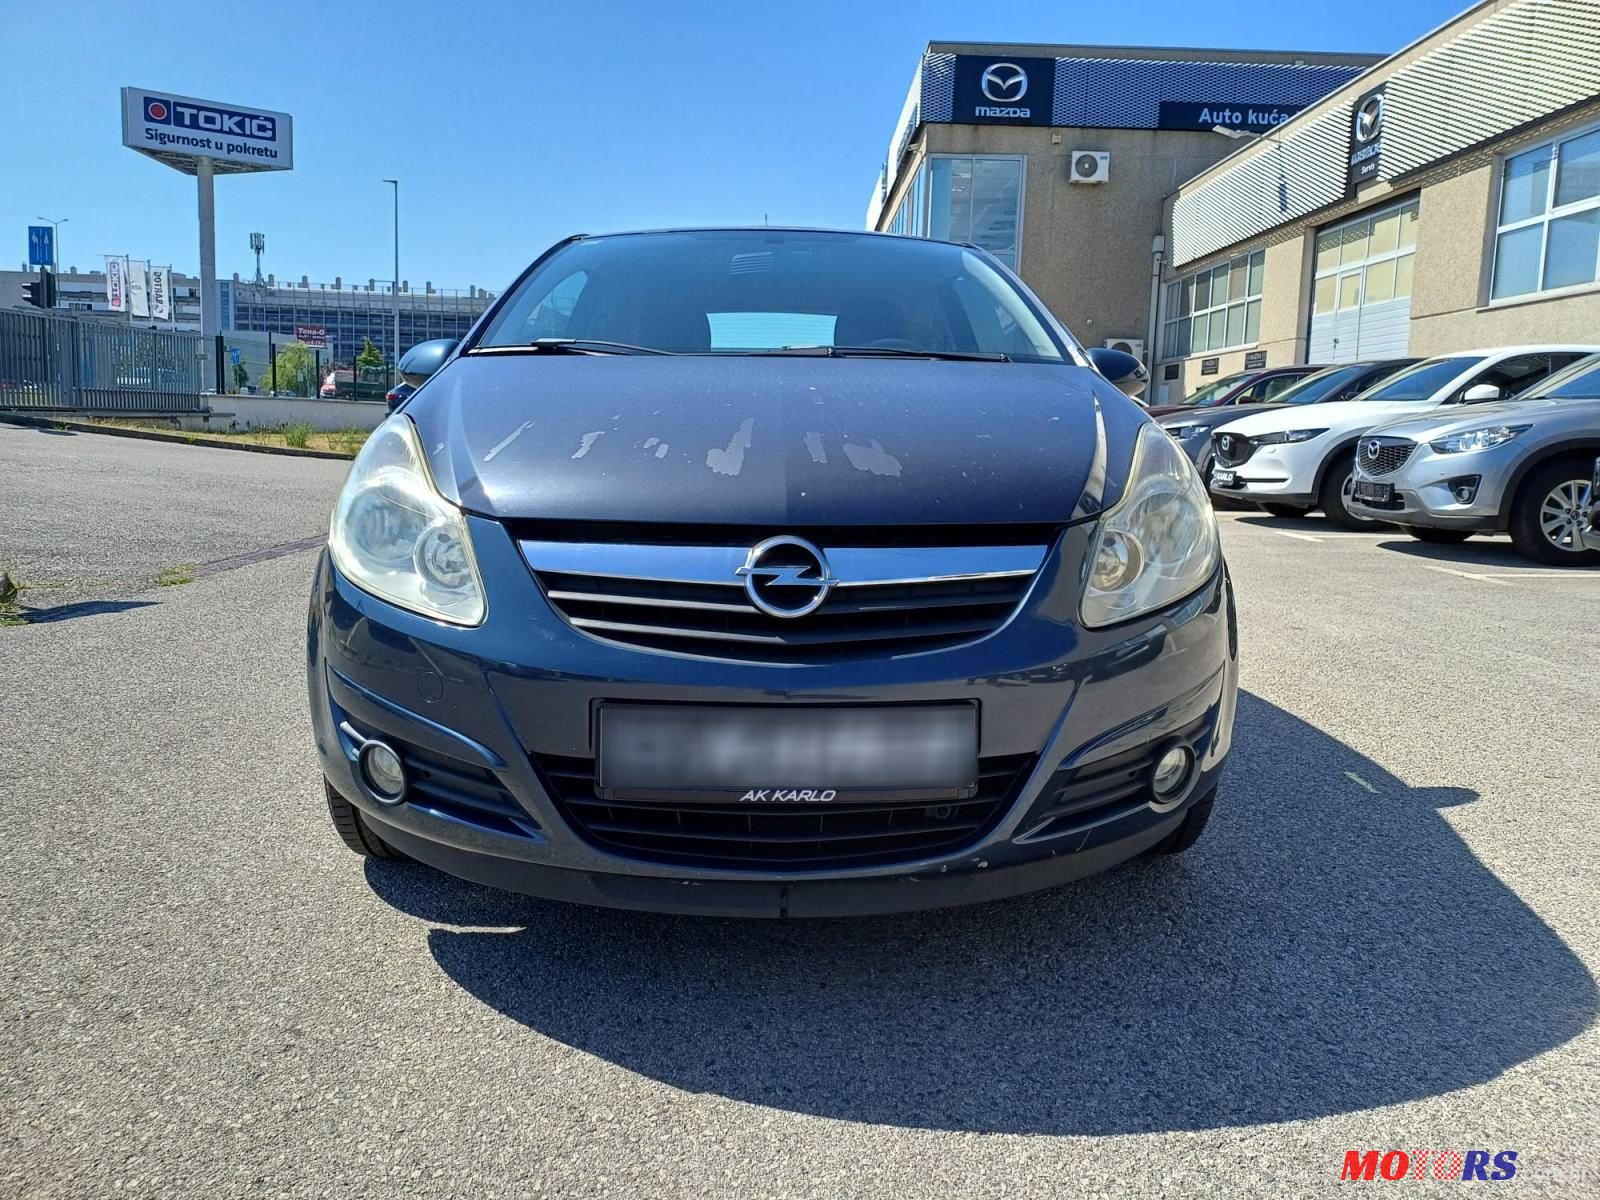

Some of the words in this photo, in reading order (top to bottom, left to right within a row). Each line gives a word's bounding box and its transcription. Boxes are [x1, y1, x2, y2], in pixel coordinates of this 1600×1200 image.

[975, 106, 1031, 118] mazda
[1198, 108, 1242, 124] Auto
[1247, 108, 1289, 125] kuća
[176, 106, 273, 138] TOKIĆ
[145, 127, 212, 149] Sigurnost
[215, 141, 223, 150] u
[227, 142, 278, 159] pokretu
[739, 789, 768, 802] AK
[771, 789, 836, 802] KARLO
